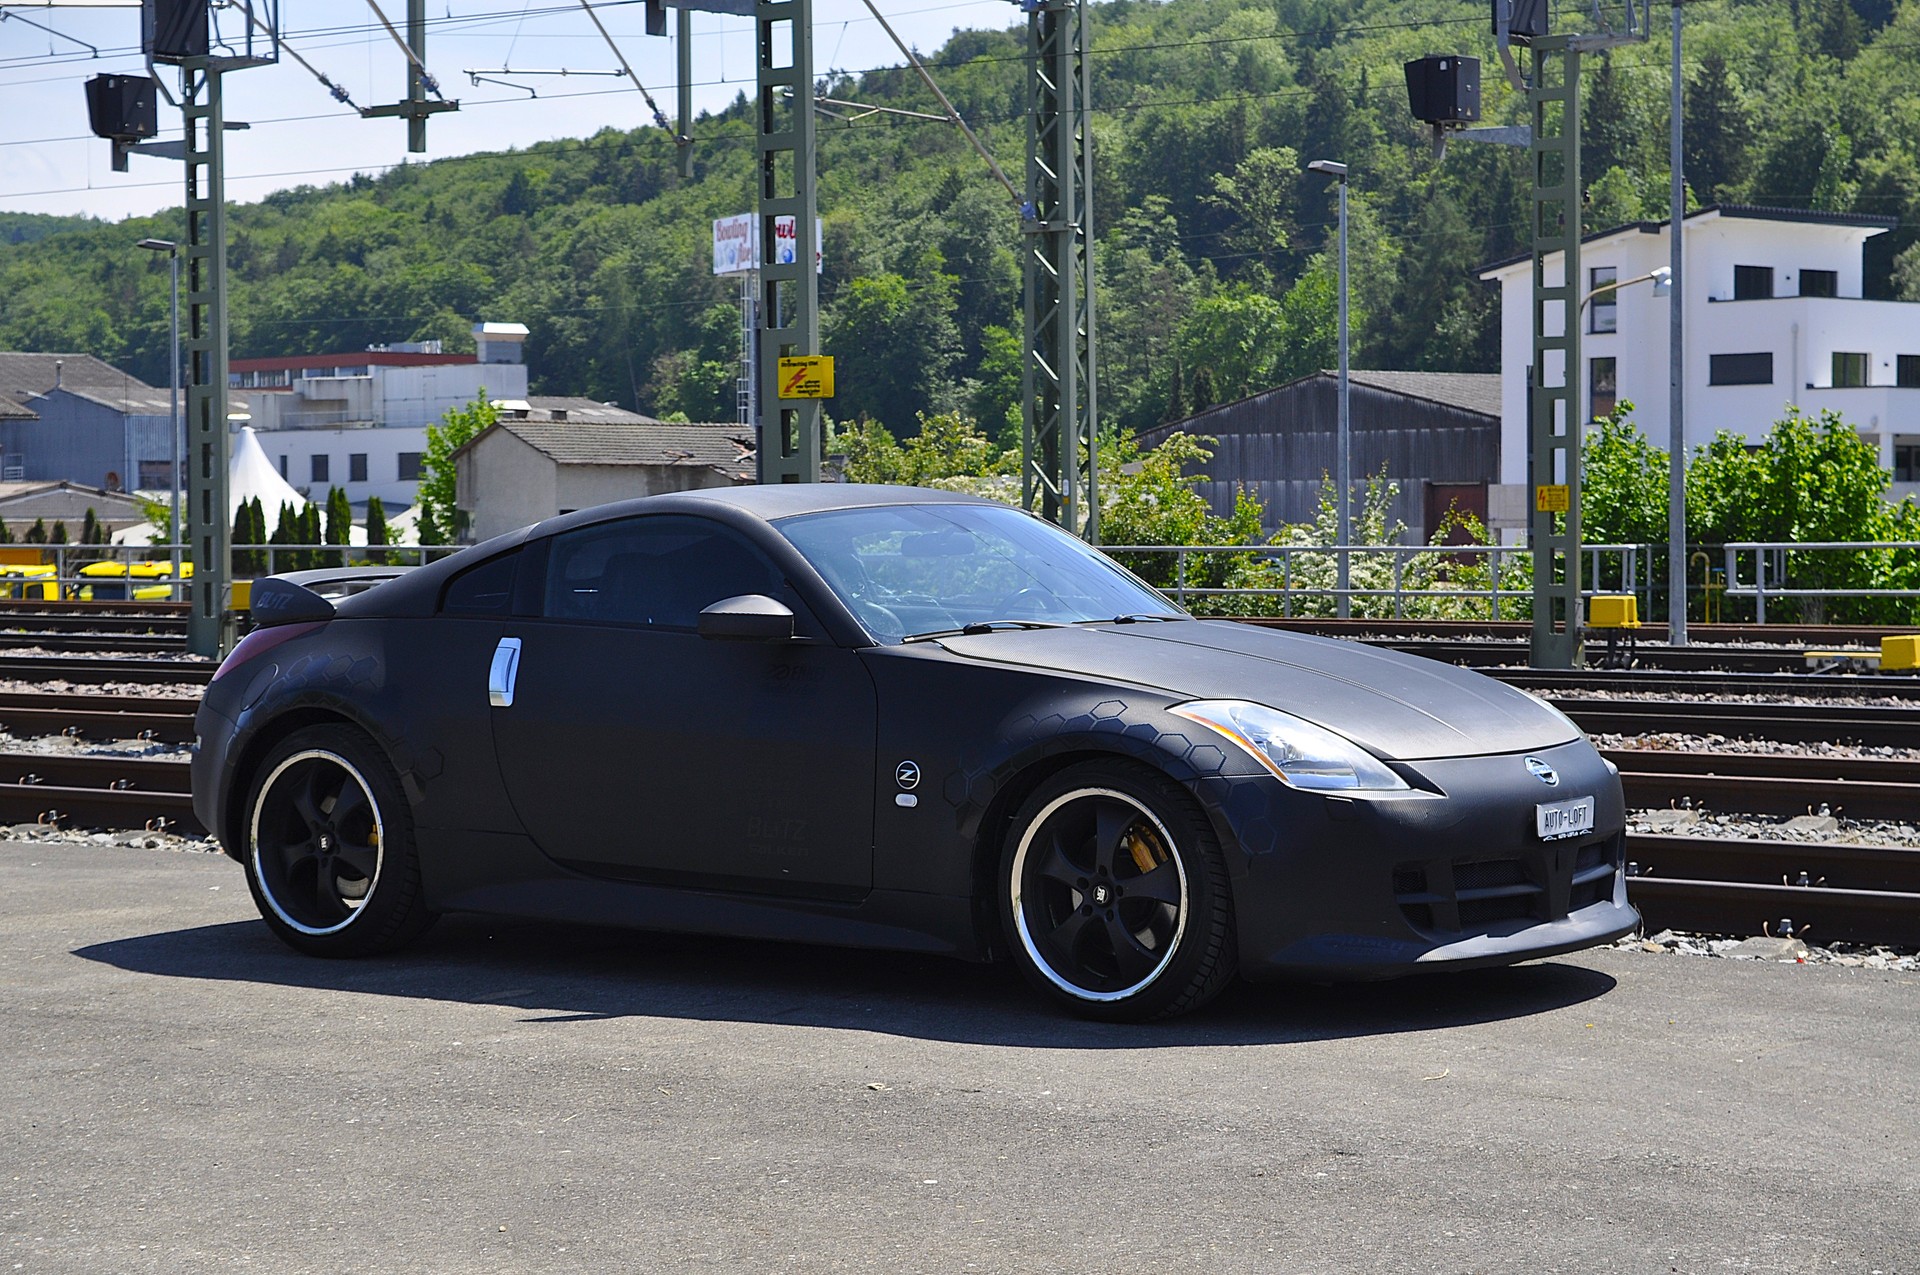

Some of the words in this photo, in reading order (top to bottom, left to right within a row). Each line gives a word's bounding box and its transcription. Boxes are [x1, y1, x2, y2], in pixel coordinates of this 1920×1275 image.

[716, 218, 748, 243] Bowling
[899, 769, 916, 782] Z
[1544, 805, 1588, 829] AUTO-LOFT
